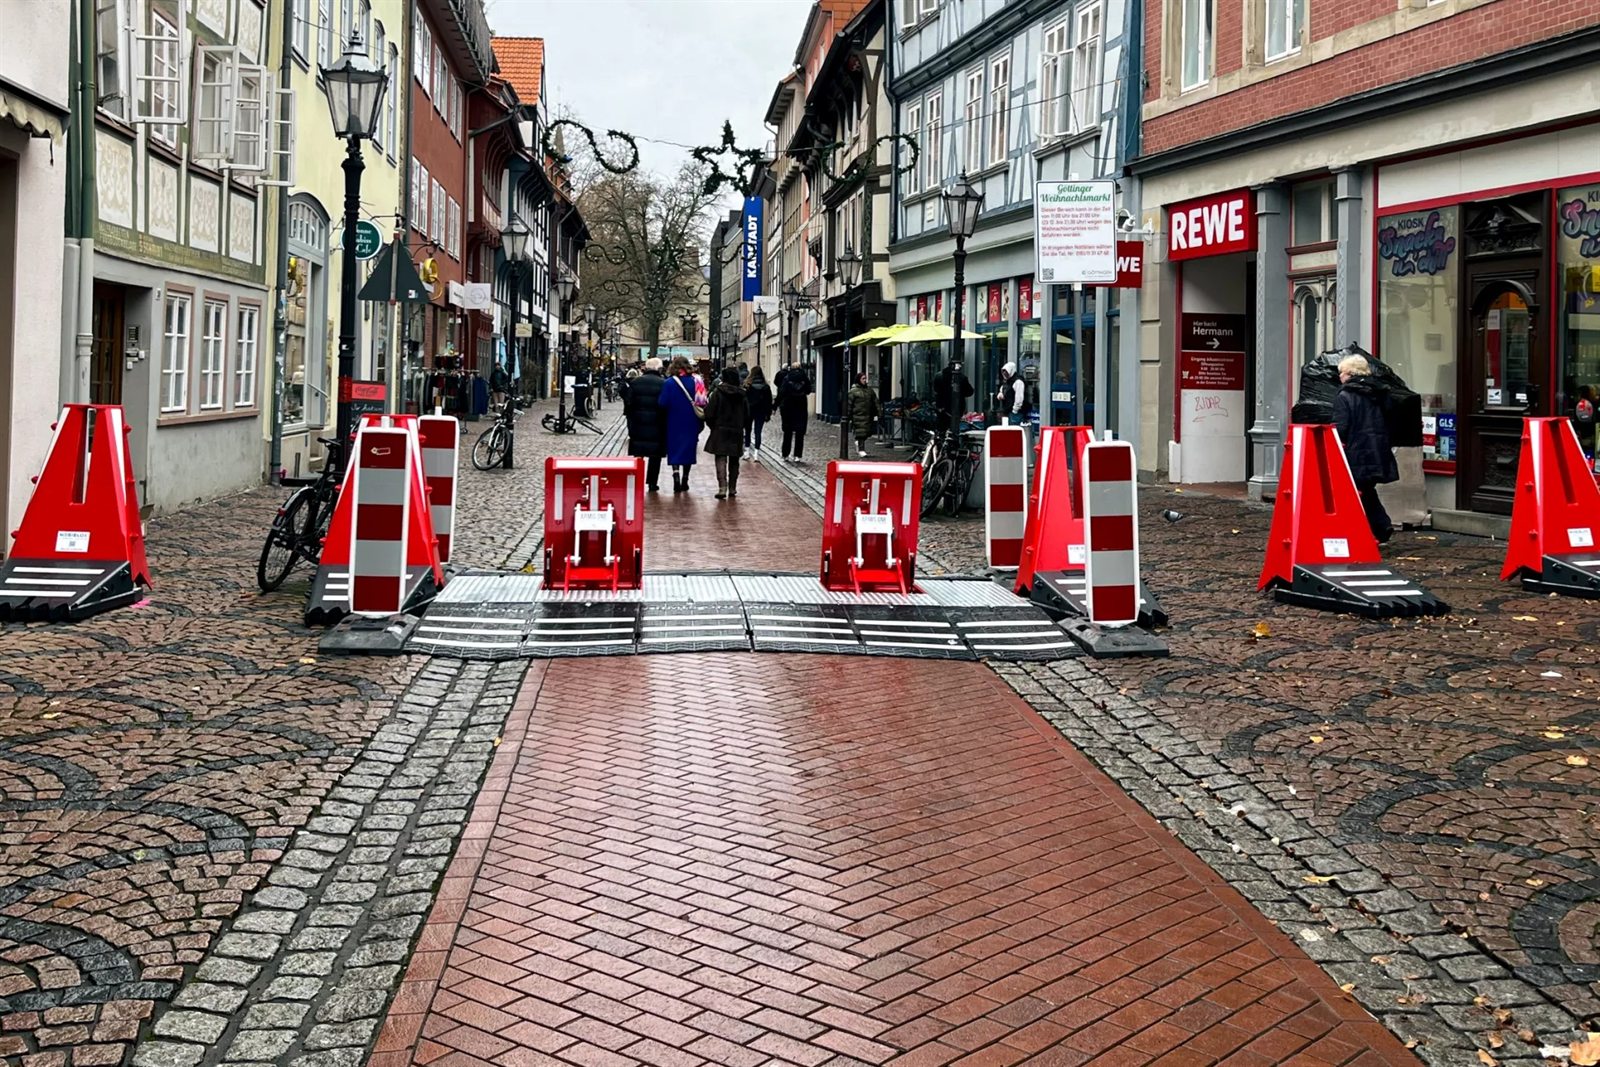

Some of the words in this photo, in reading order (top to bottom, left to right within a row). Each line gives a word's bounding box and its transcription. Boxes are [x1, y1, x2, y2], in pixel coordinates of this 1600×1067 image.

[1057, 184, 1093, 194] Göttinger
[1040, 194, 1111, 203] Weihnachtsmarkt
[1171, 199, 1244, 251] REWE
[1397, 218, 1424, 229] KIOSK
[1192, 326, 1234, 336] Hermann
[1439, 418, 1454, 428] GLS
